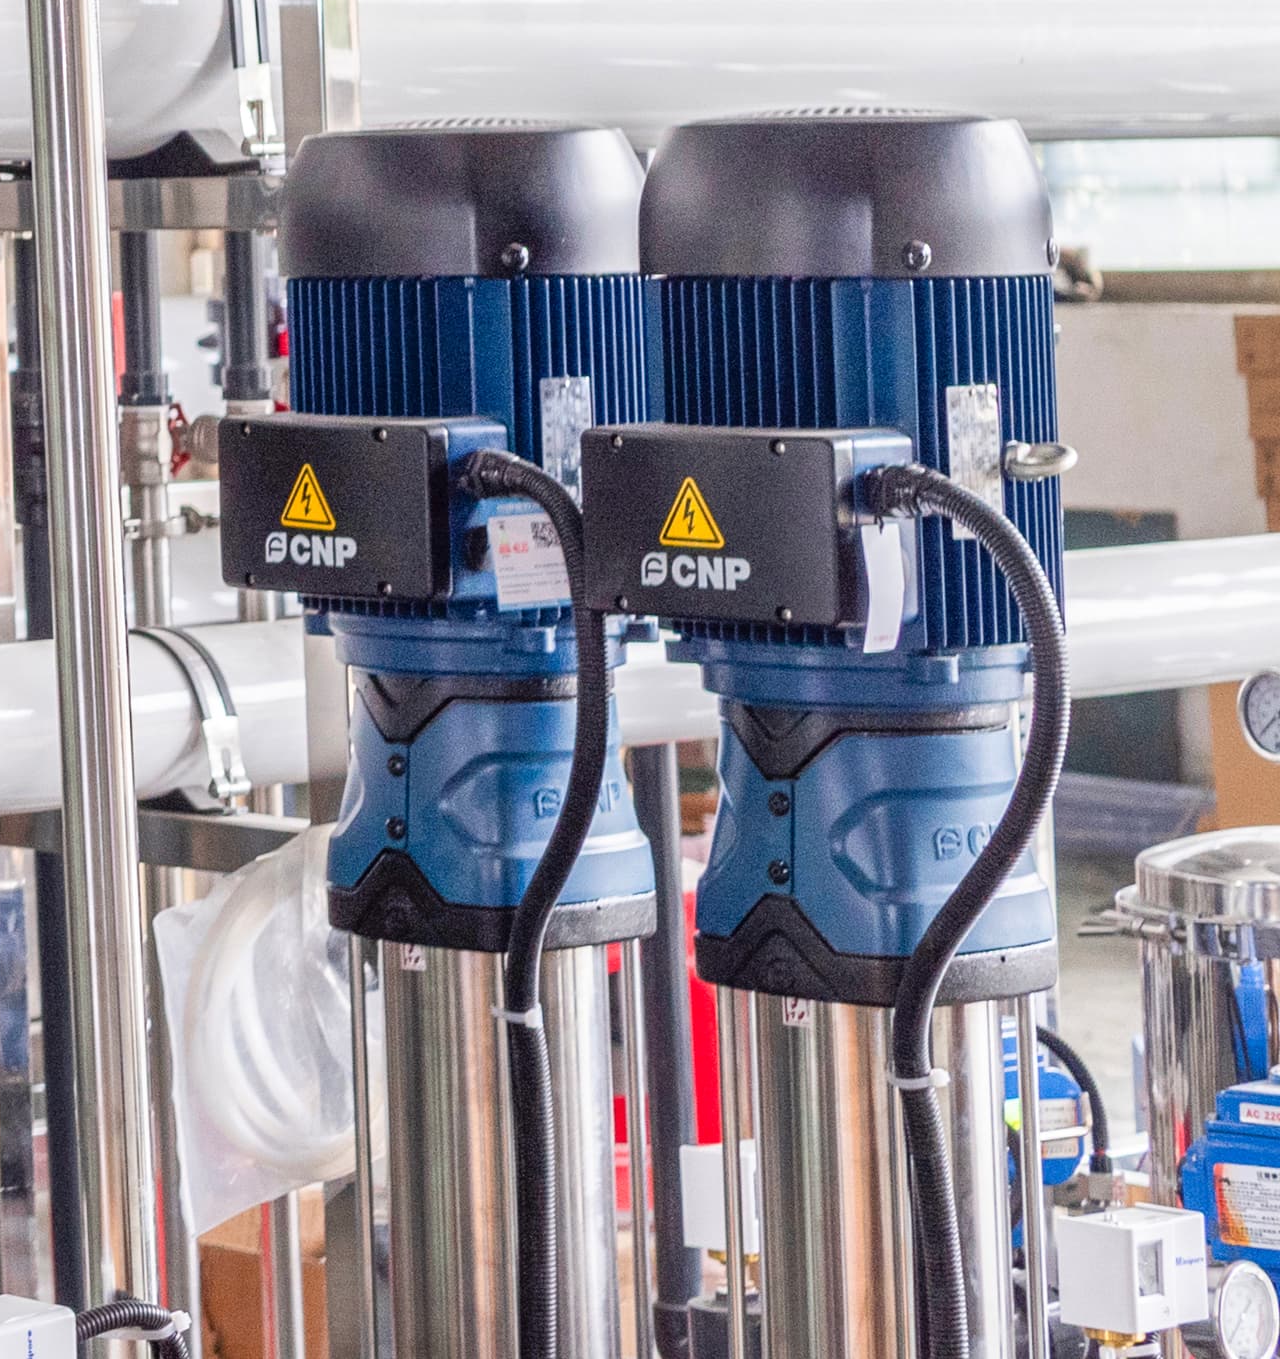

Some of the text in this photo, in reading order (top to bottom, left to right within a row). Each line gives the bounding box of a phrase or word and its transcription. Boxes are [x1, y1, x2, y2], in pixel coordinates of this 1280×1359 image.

[290, 533, 357, 569] CNP
[672, 554, 752, 591] CNP
[1246, 1107, 1260, 1120] AC
